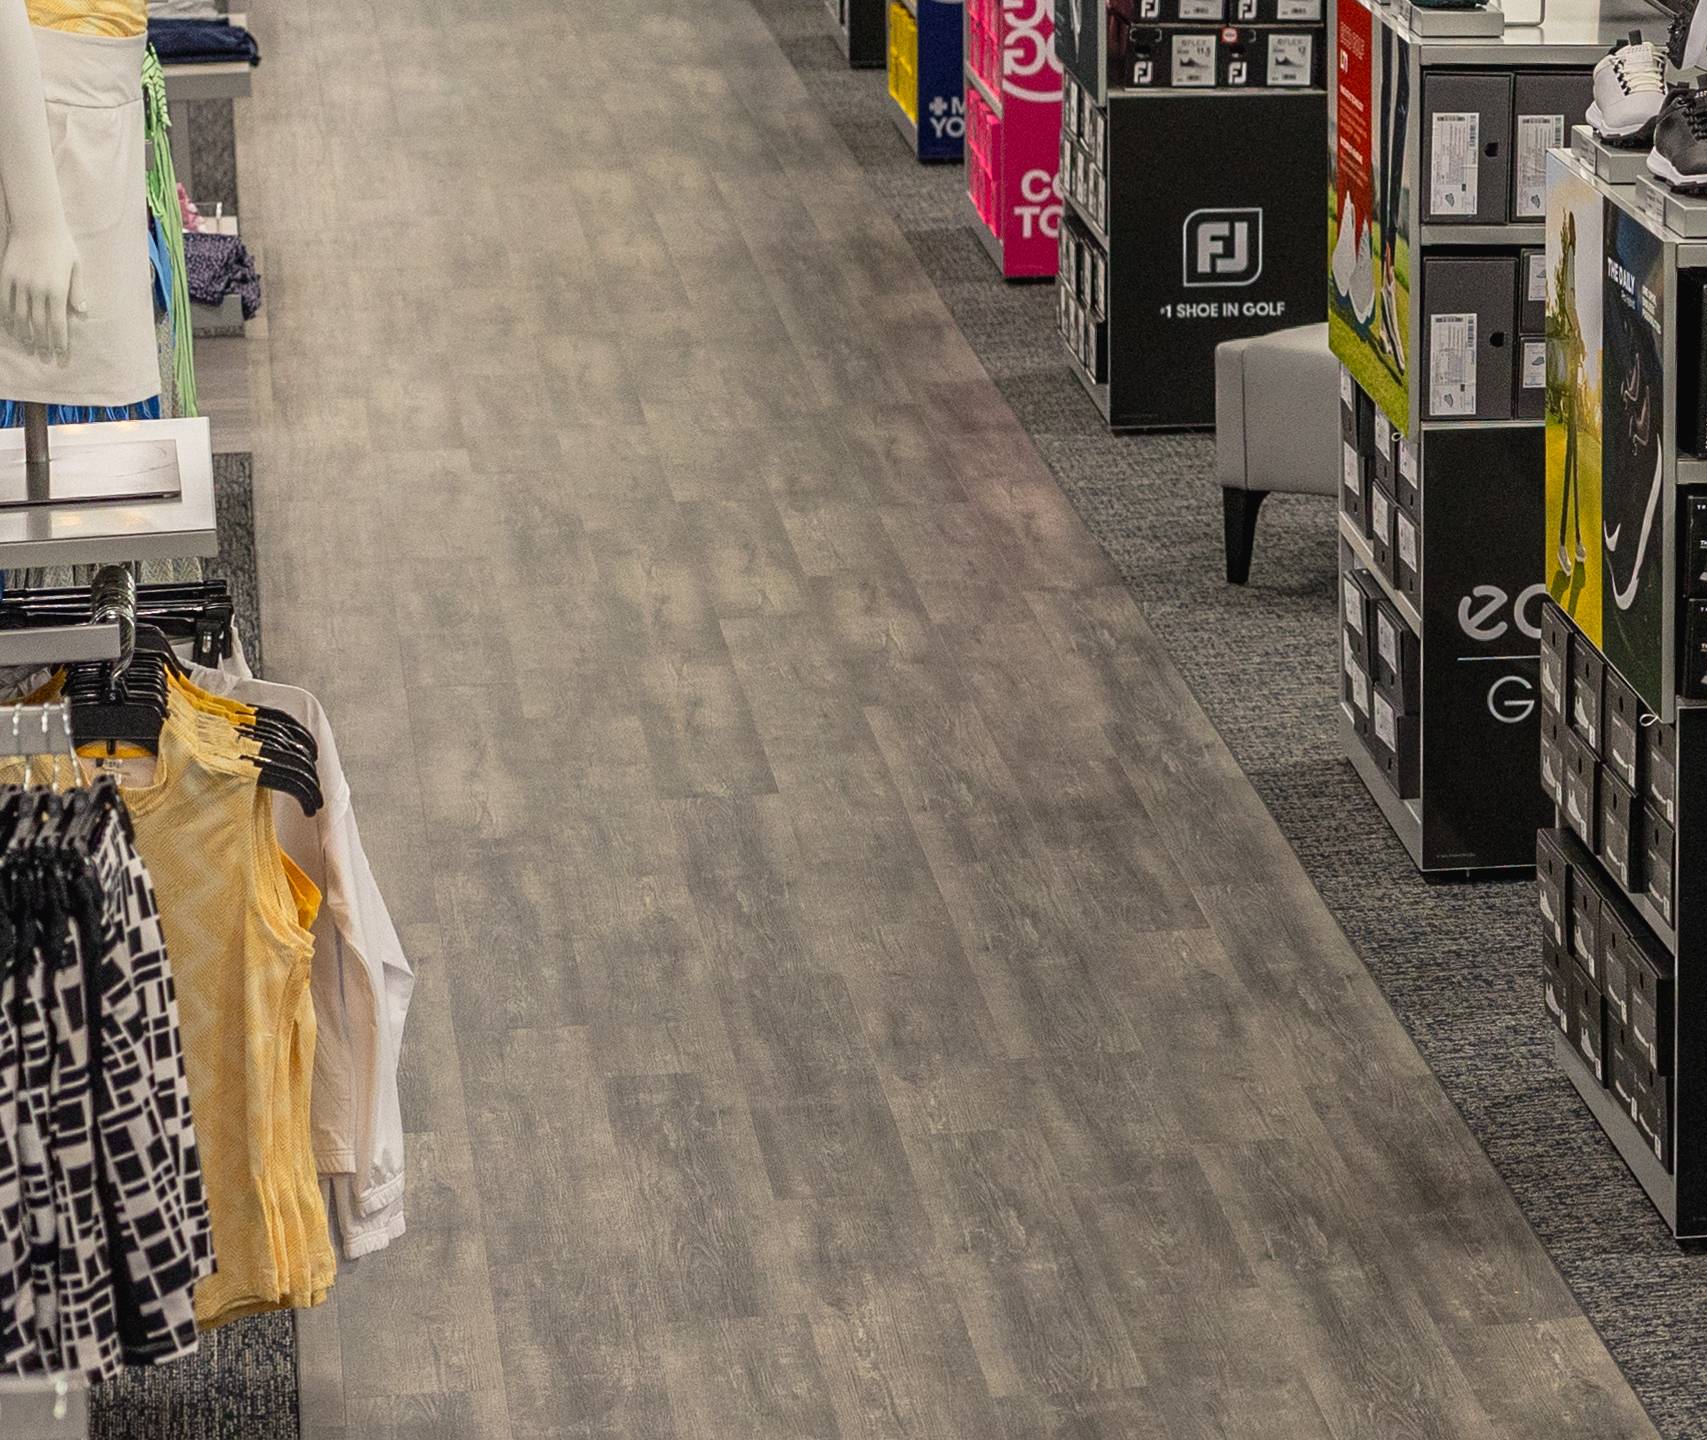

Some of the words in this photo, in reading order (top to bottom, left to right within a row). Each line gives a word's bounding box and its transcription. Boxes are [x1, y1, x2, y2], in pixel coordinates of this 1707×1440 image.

[1133, 61, 1153, 84] FJ
[1228, 61, 1248, 84] FJ
[1197, 221, 1249, 274] FJ
[1176, 303, 1219, 318] SHOE
[1222, 303, 1240, 318] IN
[1242, 301, 1286, 317] GOLF
[1458, 584, 1548, 642] ec
